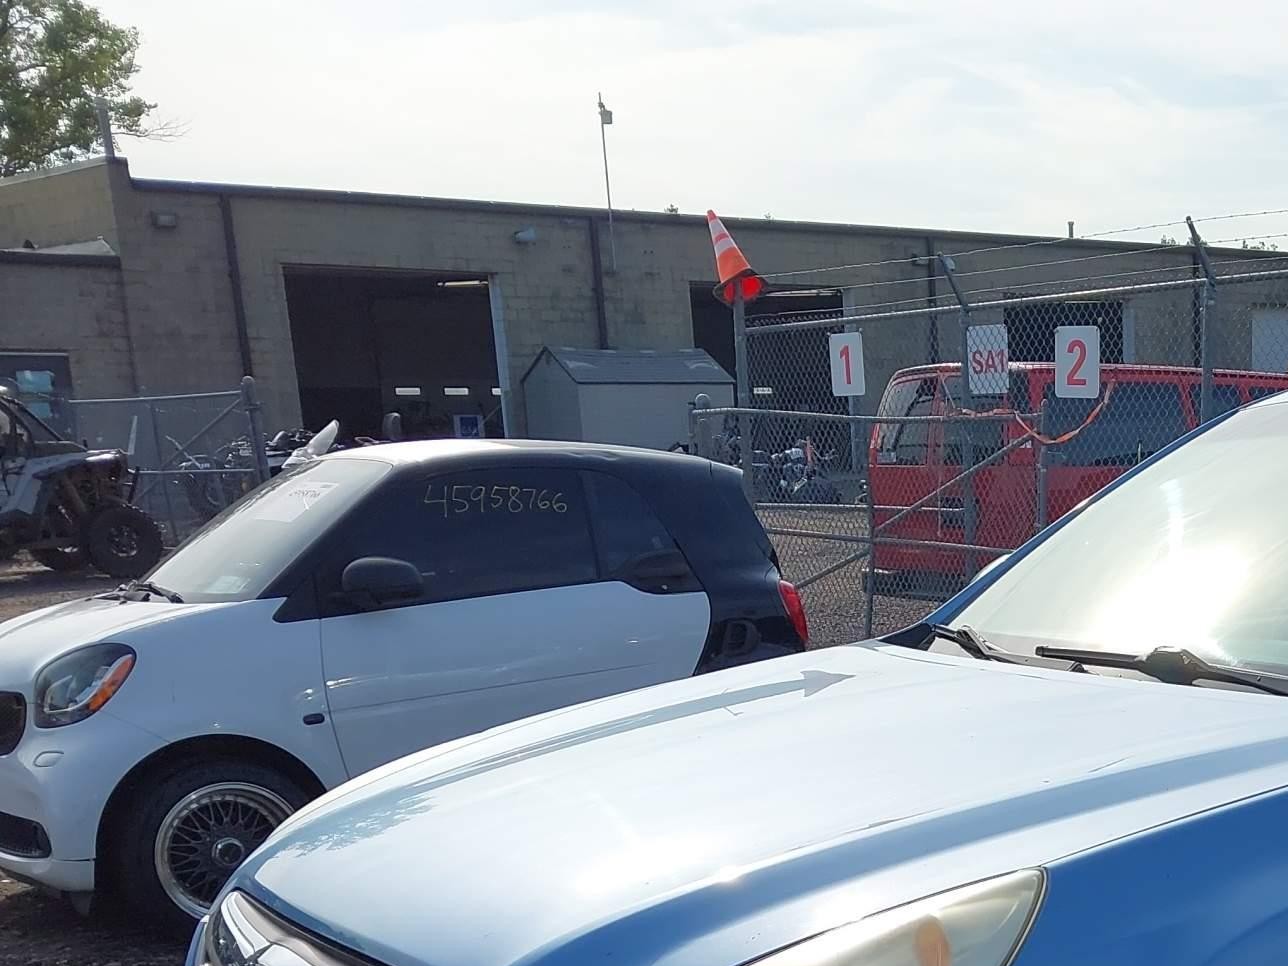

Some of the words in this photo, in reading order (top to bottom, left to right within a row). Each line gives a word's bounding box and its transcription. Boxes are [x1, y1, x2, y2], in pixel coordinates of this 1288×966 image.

[839, 344, 851, 384] 1
[972, 350, 1005, 374] SA1
[1066, 340, 1087, 385] 2
[424, 485, 568, 517] 45958766
